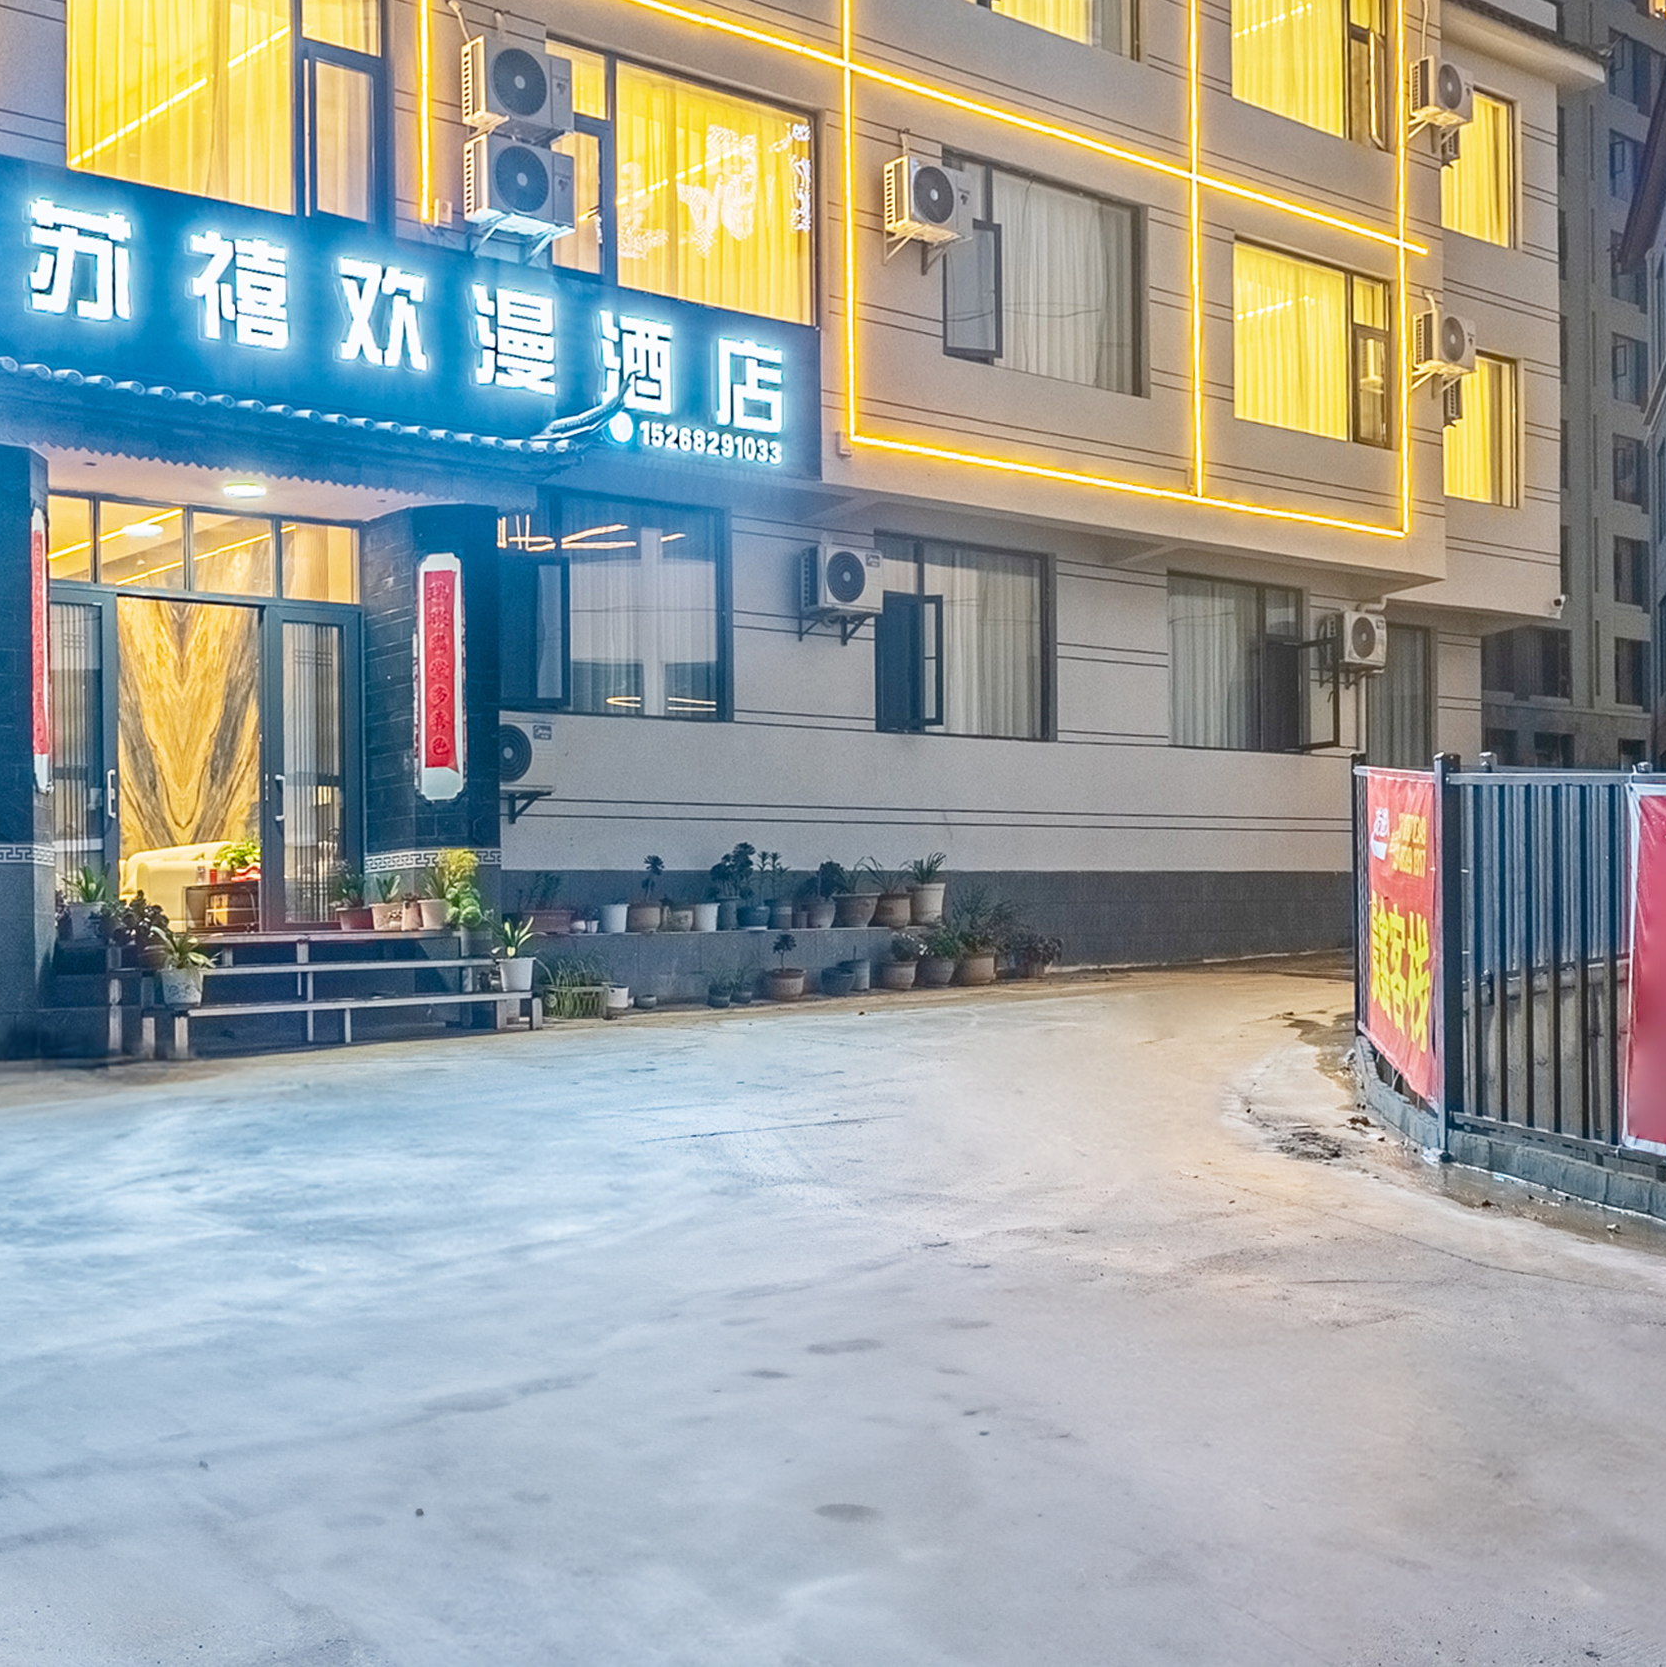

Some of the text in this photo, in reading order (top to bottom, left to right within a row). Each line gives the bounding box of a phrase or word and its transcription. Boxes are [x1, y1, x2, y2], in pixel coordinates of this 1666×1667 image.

[28, 197, 784, 434] 苏禧欢漫酒店
[639, 420, 783, 465] 15268291033
